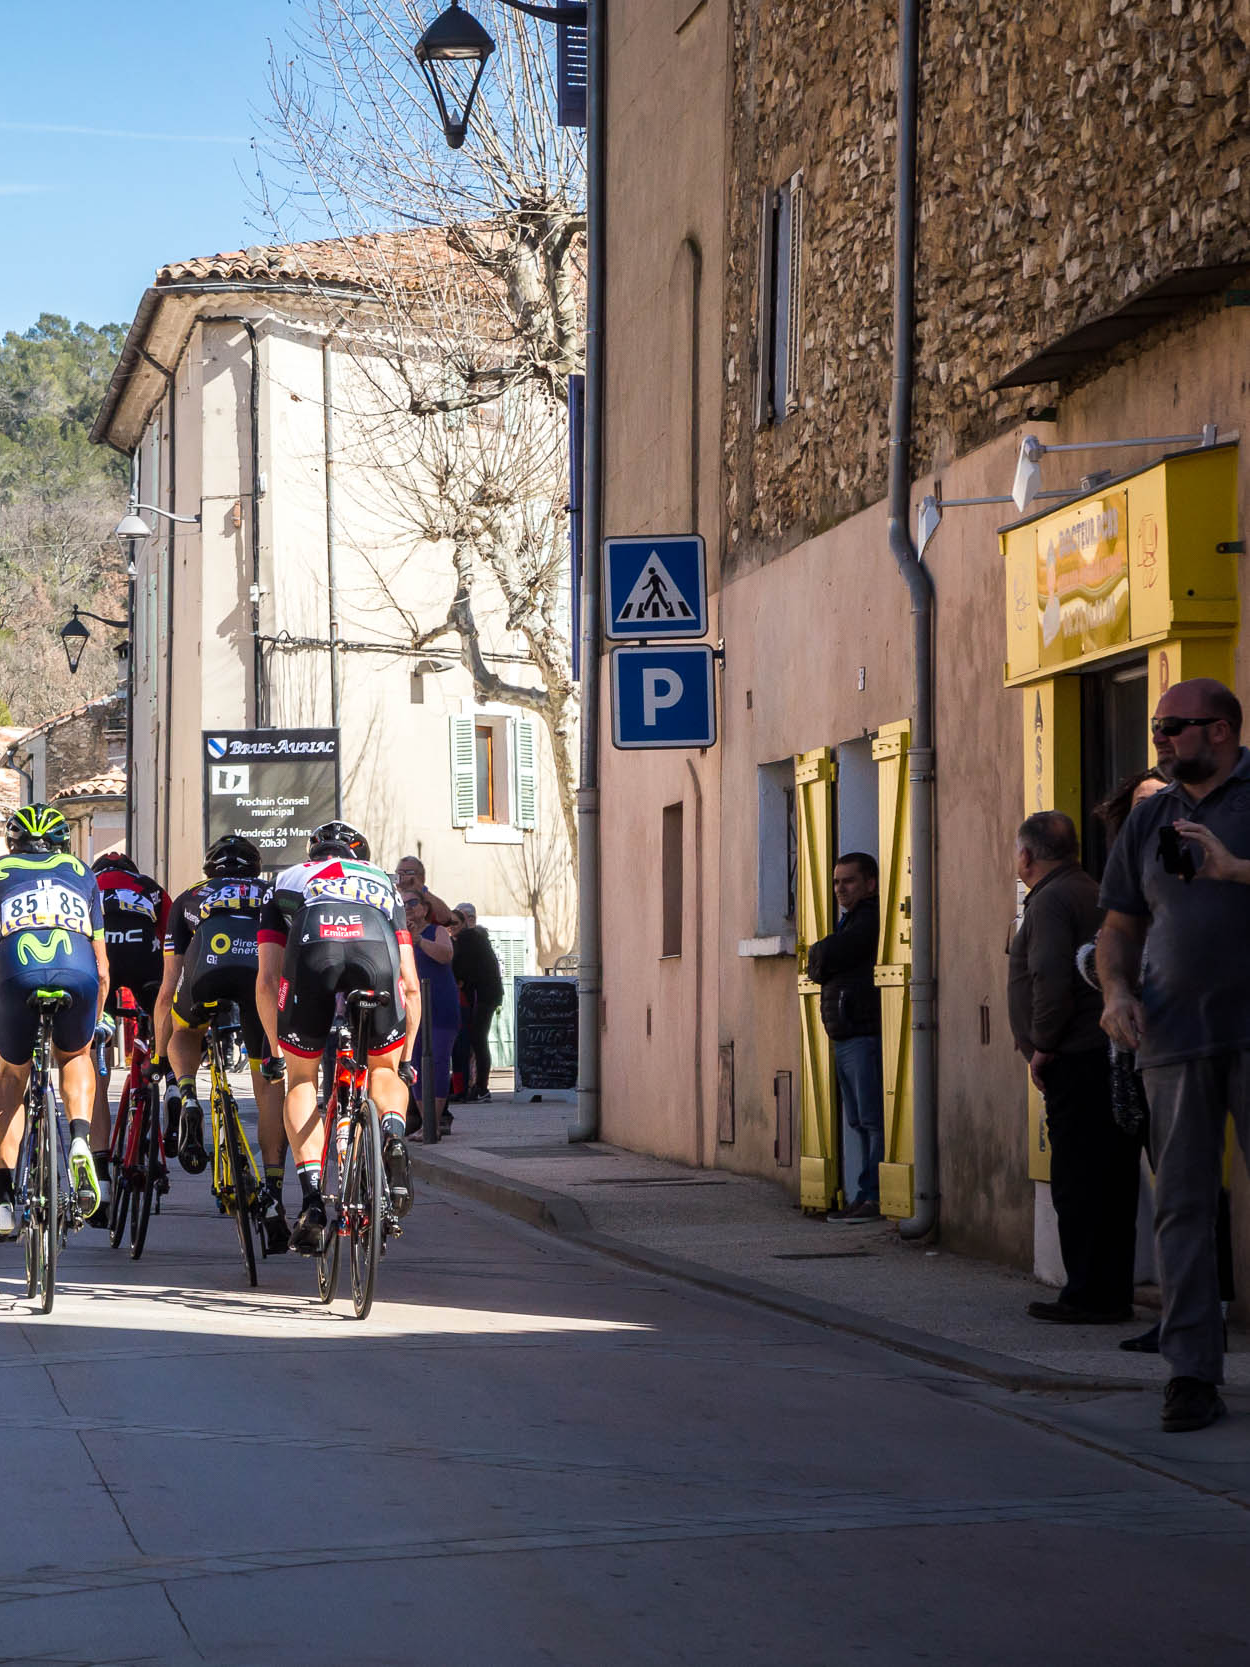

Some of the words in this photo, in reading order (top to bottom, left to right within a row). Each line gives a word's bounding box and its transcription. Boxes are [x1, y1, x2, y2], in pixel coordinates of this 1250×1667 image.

[642, 667, 684, 726] P
[236, 797, 275, 806] Prochain
[277, 796, 309, 805] Conseil
[251, 807, 294, 818] municipal
[234, 828, 275, 838] Vendredi
[276, 828, 288, 837] 24
[290, 828, 312, 837] Mars
[259, 838, 287, 848] 20h30
[10, 893, 39, 918] 85
[60, 892, 86, 918] 85
[5, 913, 46, 933] LCL
[54, 913, 85, 934] LCL
[320, 914, 362, 925] UAE
[232, 938, 258, 947] direc
